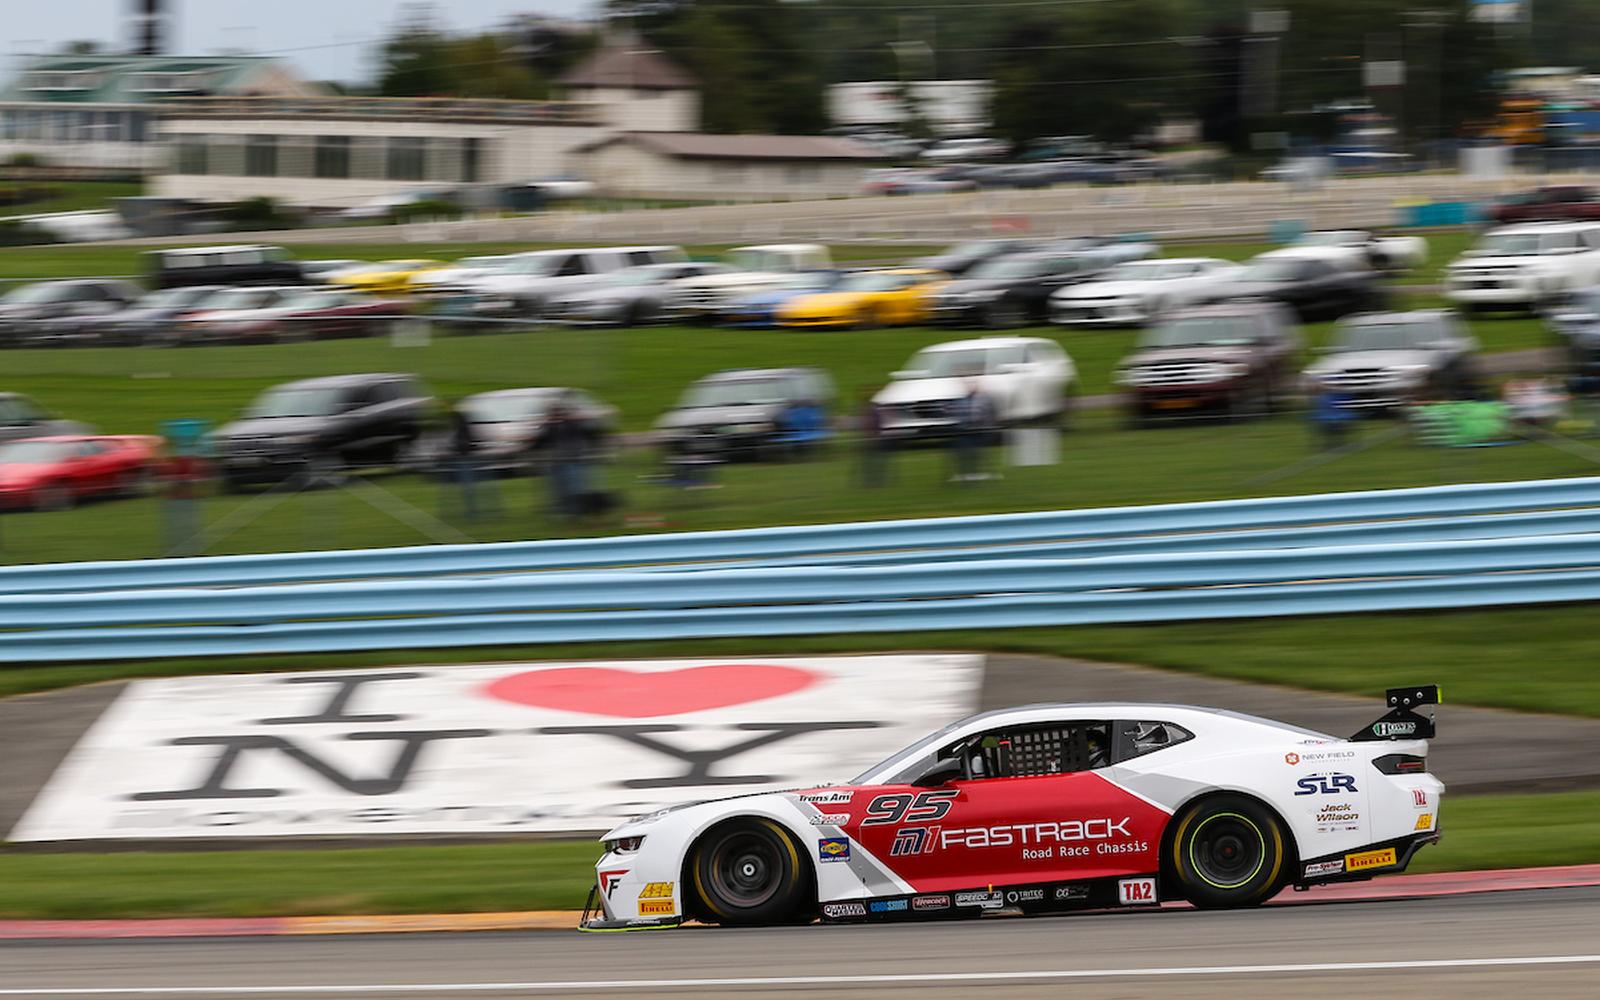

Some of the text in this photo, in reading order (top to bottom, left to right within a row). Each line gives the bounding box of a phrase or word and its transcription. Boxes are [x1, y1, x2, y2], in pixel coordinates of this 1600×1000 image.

[262, 671, 428, 725] I
[130, 720, 882, 804] NY
[1328, 751, 1355, 759] FIELD
[1294, 775, 1359, 796] SLR
[798, 792, 851, 803] Trans Am
[860, 790, 960, 826] 95
[1321, 803, 1352, 812] Jack
[1316, 813, 1359, 822] Wilson
[1022, 840, 1148, 861] Road Race Chassis
[1350, 851, 1392, 868] PIRELLI
[1123, 881, 1152, 901] TA2
[641, 901, 673, 913] PIRELLI
